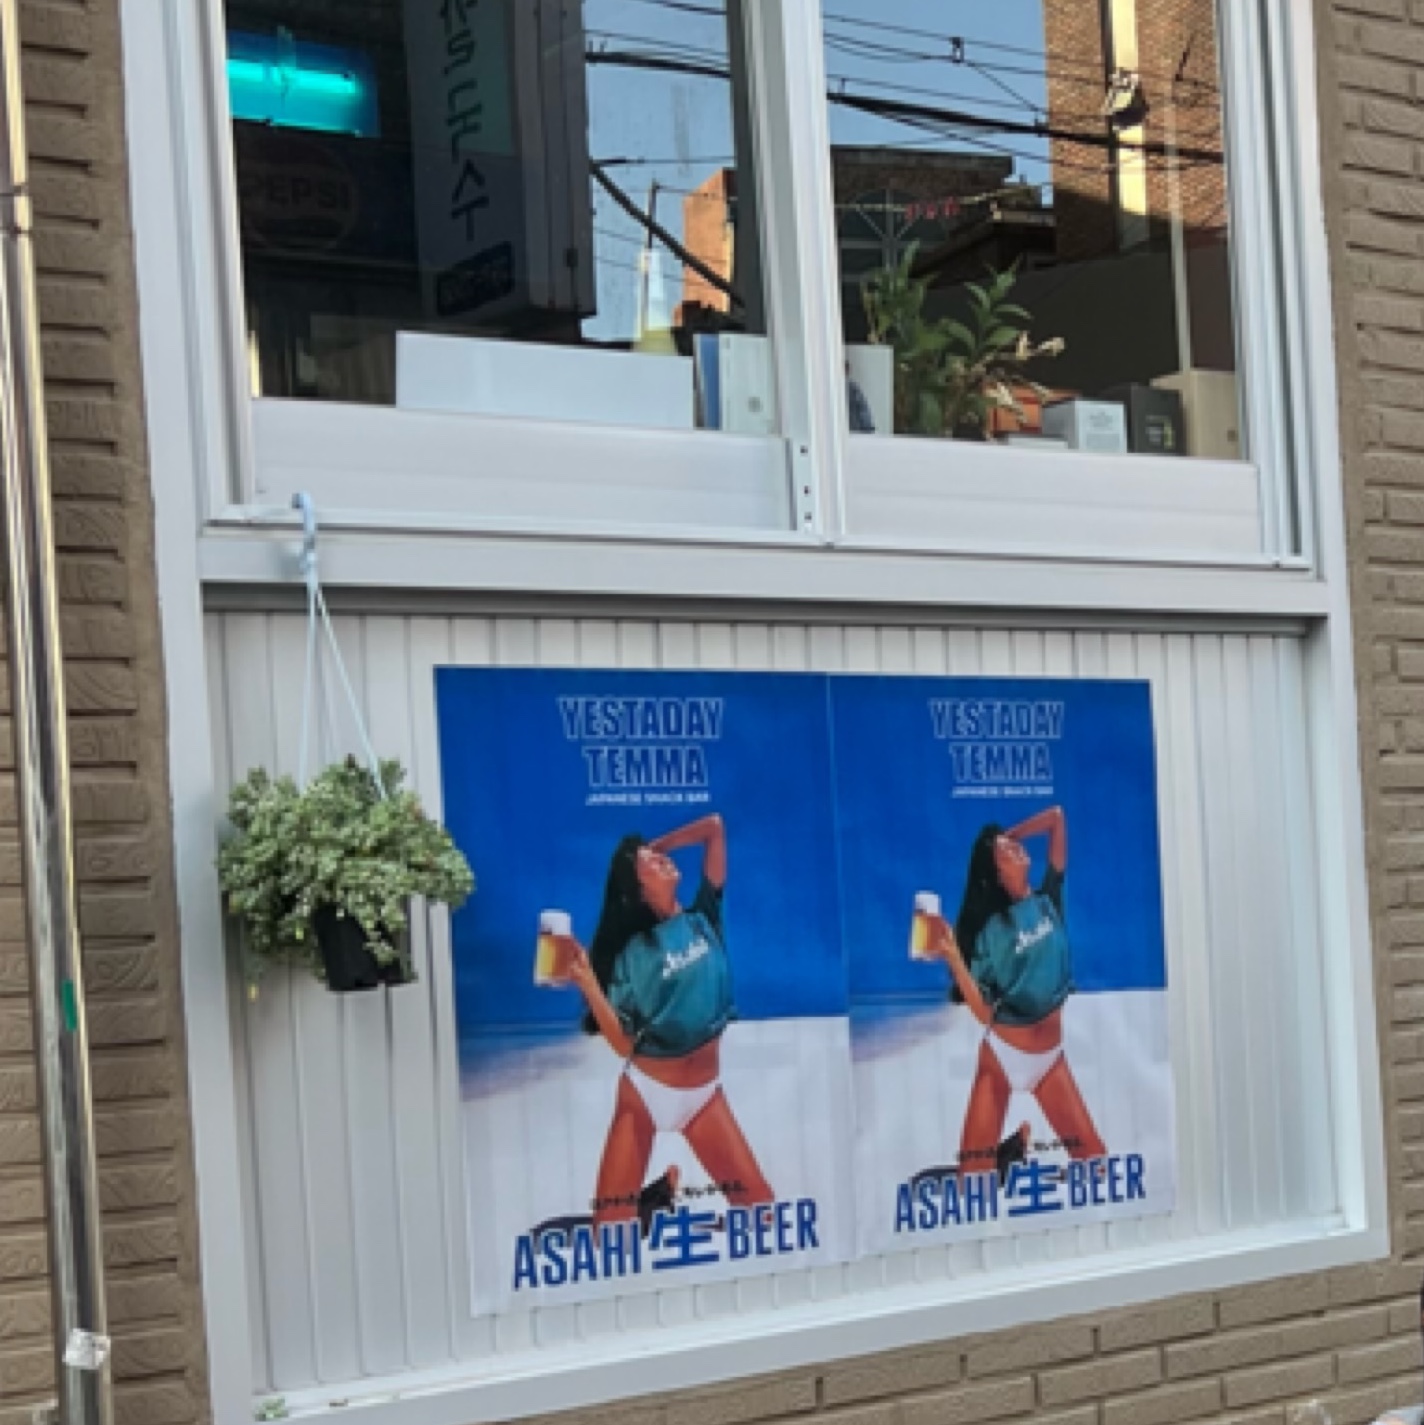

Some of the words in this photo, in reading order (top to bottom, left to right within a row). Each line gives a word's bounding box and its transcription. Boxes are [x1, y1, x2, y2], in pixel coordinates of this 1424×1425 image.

[557, 695, 724, 740] YESTADAY
[929, 698, 1065, 740] YESTADAY
[581, 745, 709, 788] TEMMA
[949, 741, 1053, 784] TEMMA
[894, 1172, 998, 1232] ASAHI
[1004, 1157, 1064, 1218] 生
[1068, 1153, 1146, 1210] BEER
[513, 1218, 642, 1291] ASAHI
[650, 1204, 720, 1270] 生
[726, 1197, 819, 1259] BEER
